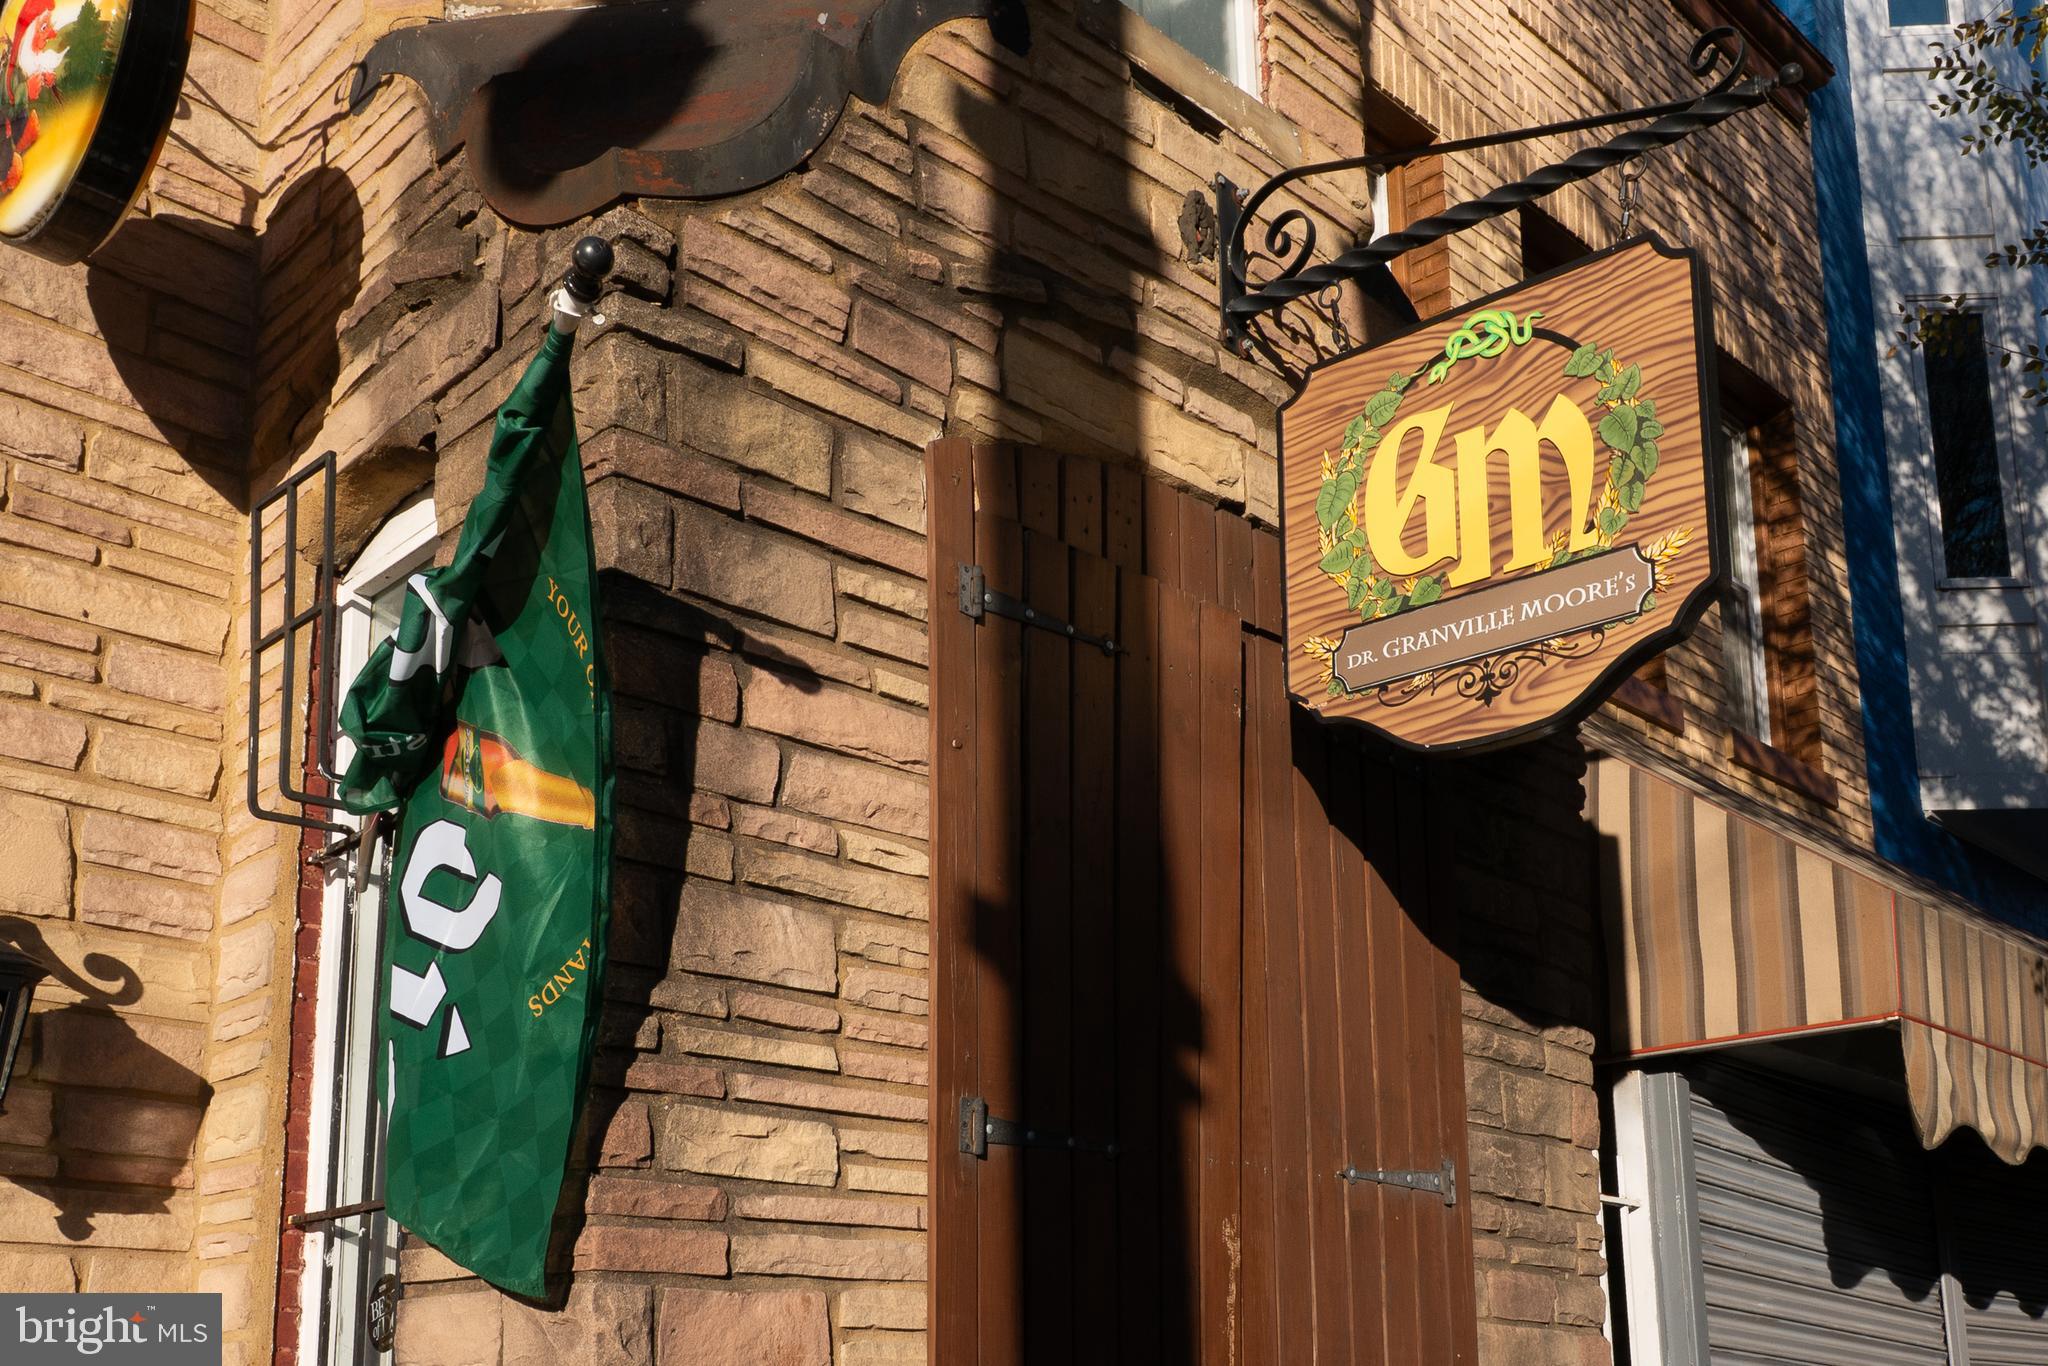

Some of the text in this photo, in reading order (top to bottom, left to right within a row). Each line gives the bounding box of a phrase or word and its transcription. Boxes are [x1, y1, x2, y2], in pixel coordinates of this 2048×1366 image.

[547, 577, 588, 659] YOUR
[1347, 649, 1378, 670] DR.
[1382, 606, 1515, 659] GRANVILLE
